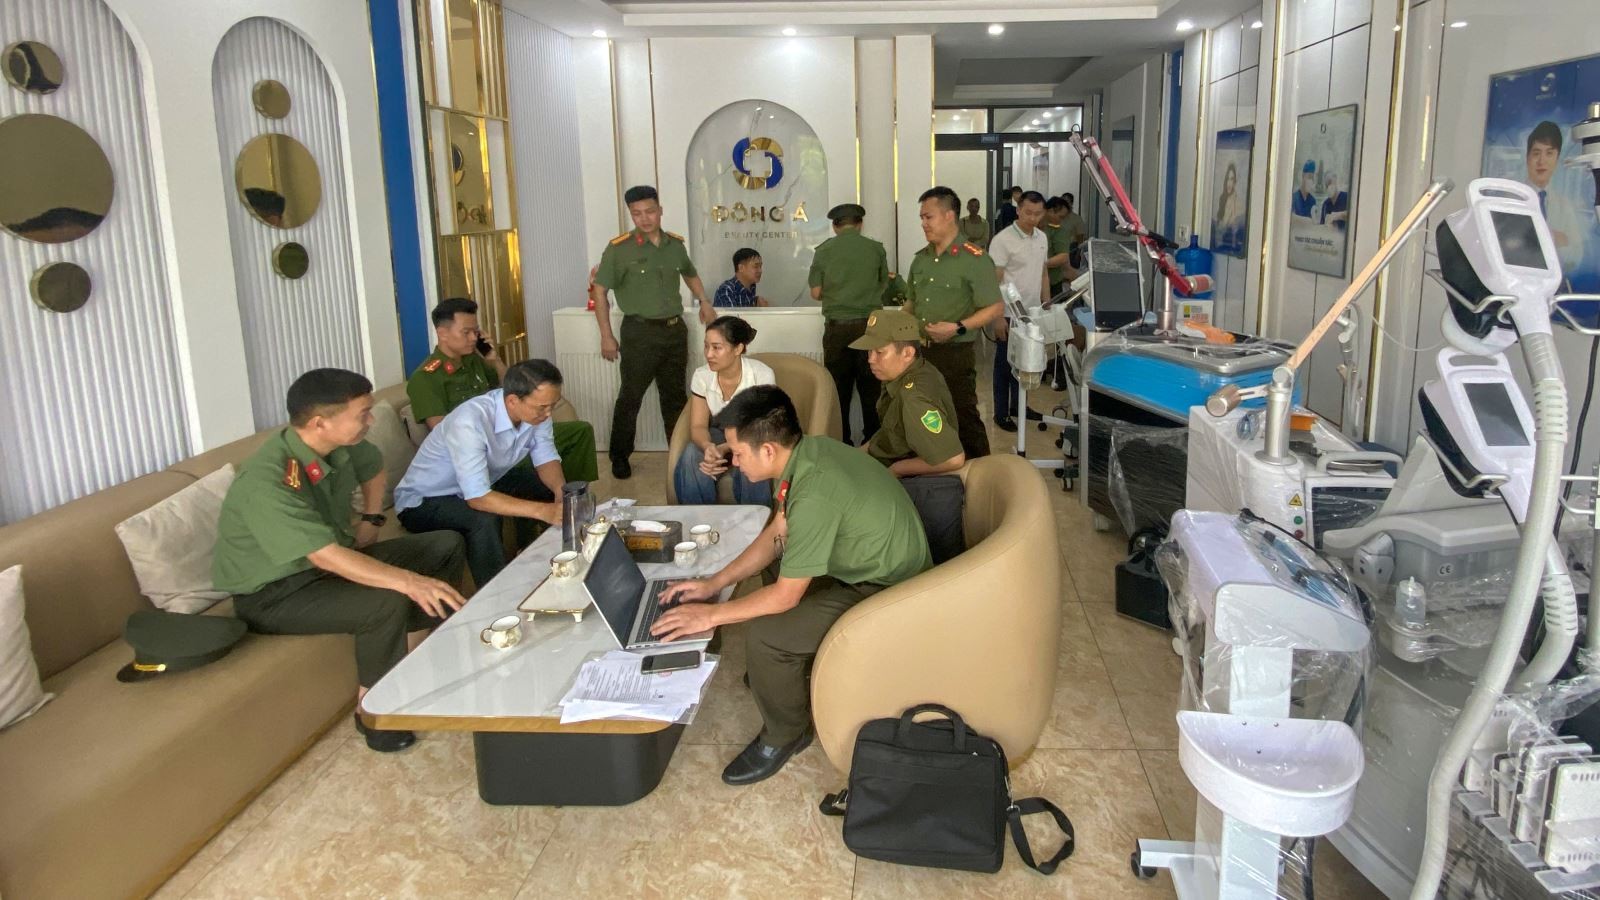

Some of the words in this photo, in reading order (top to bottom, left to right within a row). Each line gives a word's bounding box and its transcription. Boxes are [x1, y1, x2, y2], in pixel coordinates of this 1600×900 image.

[792, 201, 809, 222] Á
[724, 231, 760, 239] BEAUTY
[761, 231, 798, 239] CENTER
[1439, 565, 1451, 575] CE
